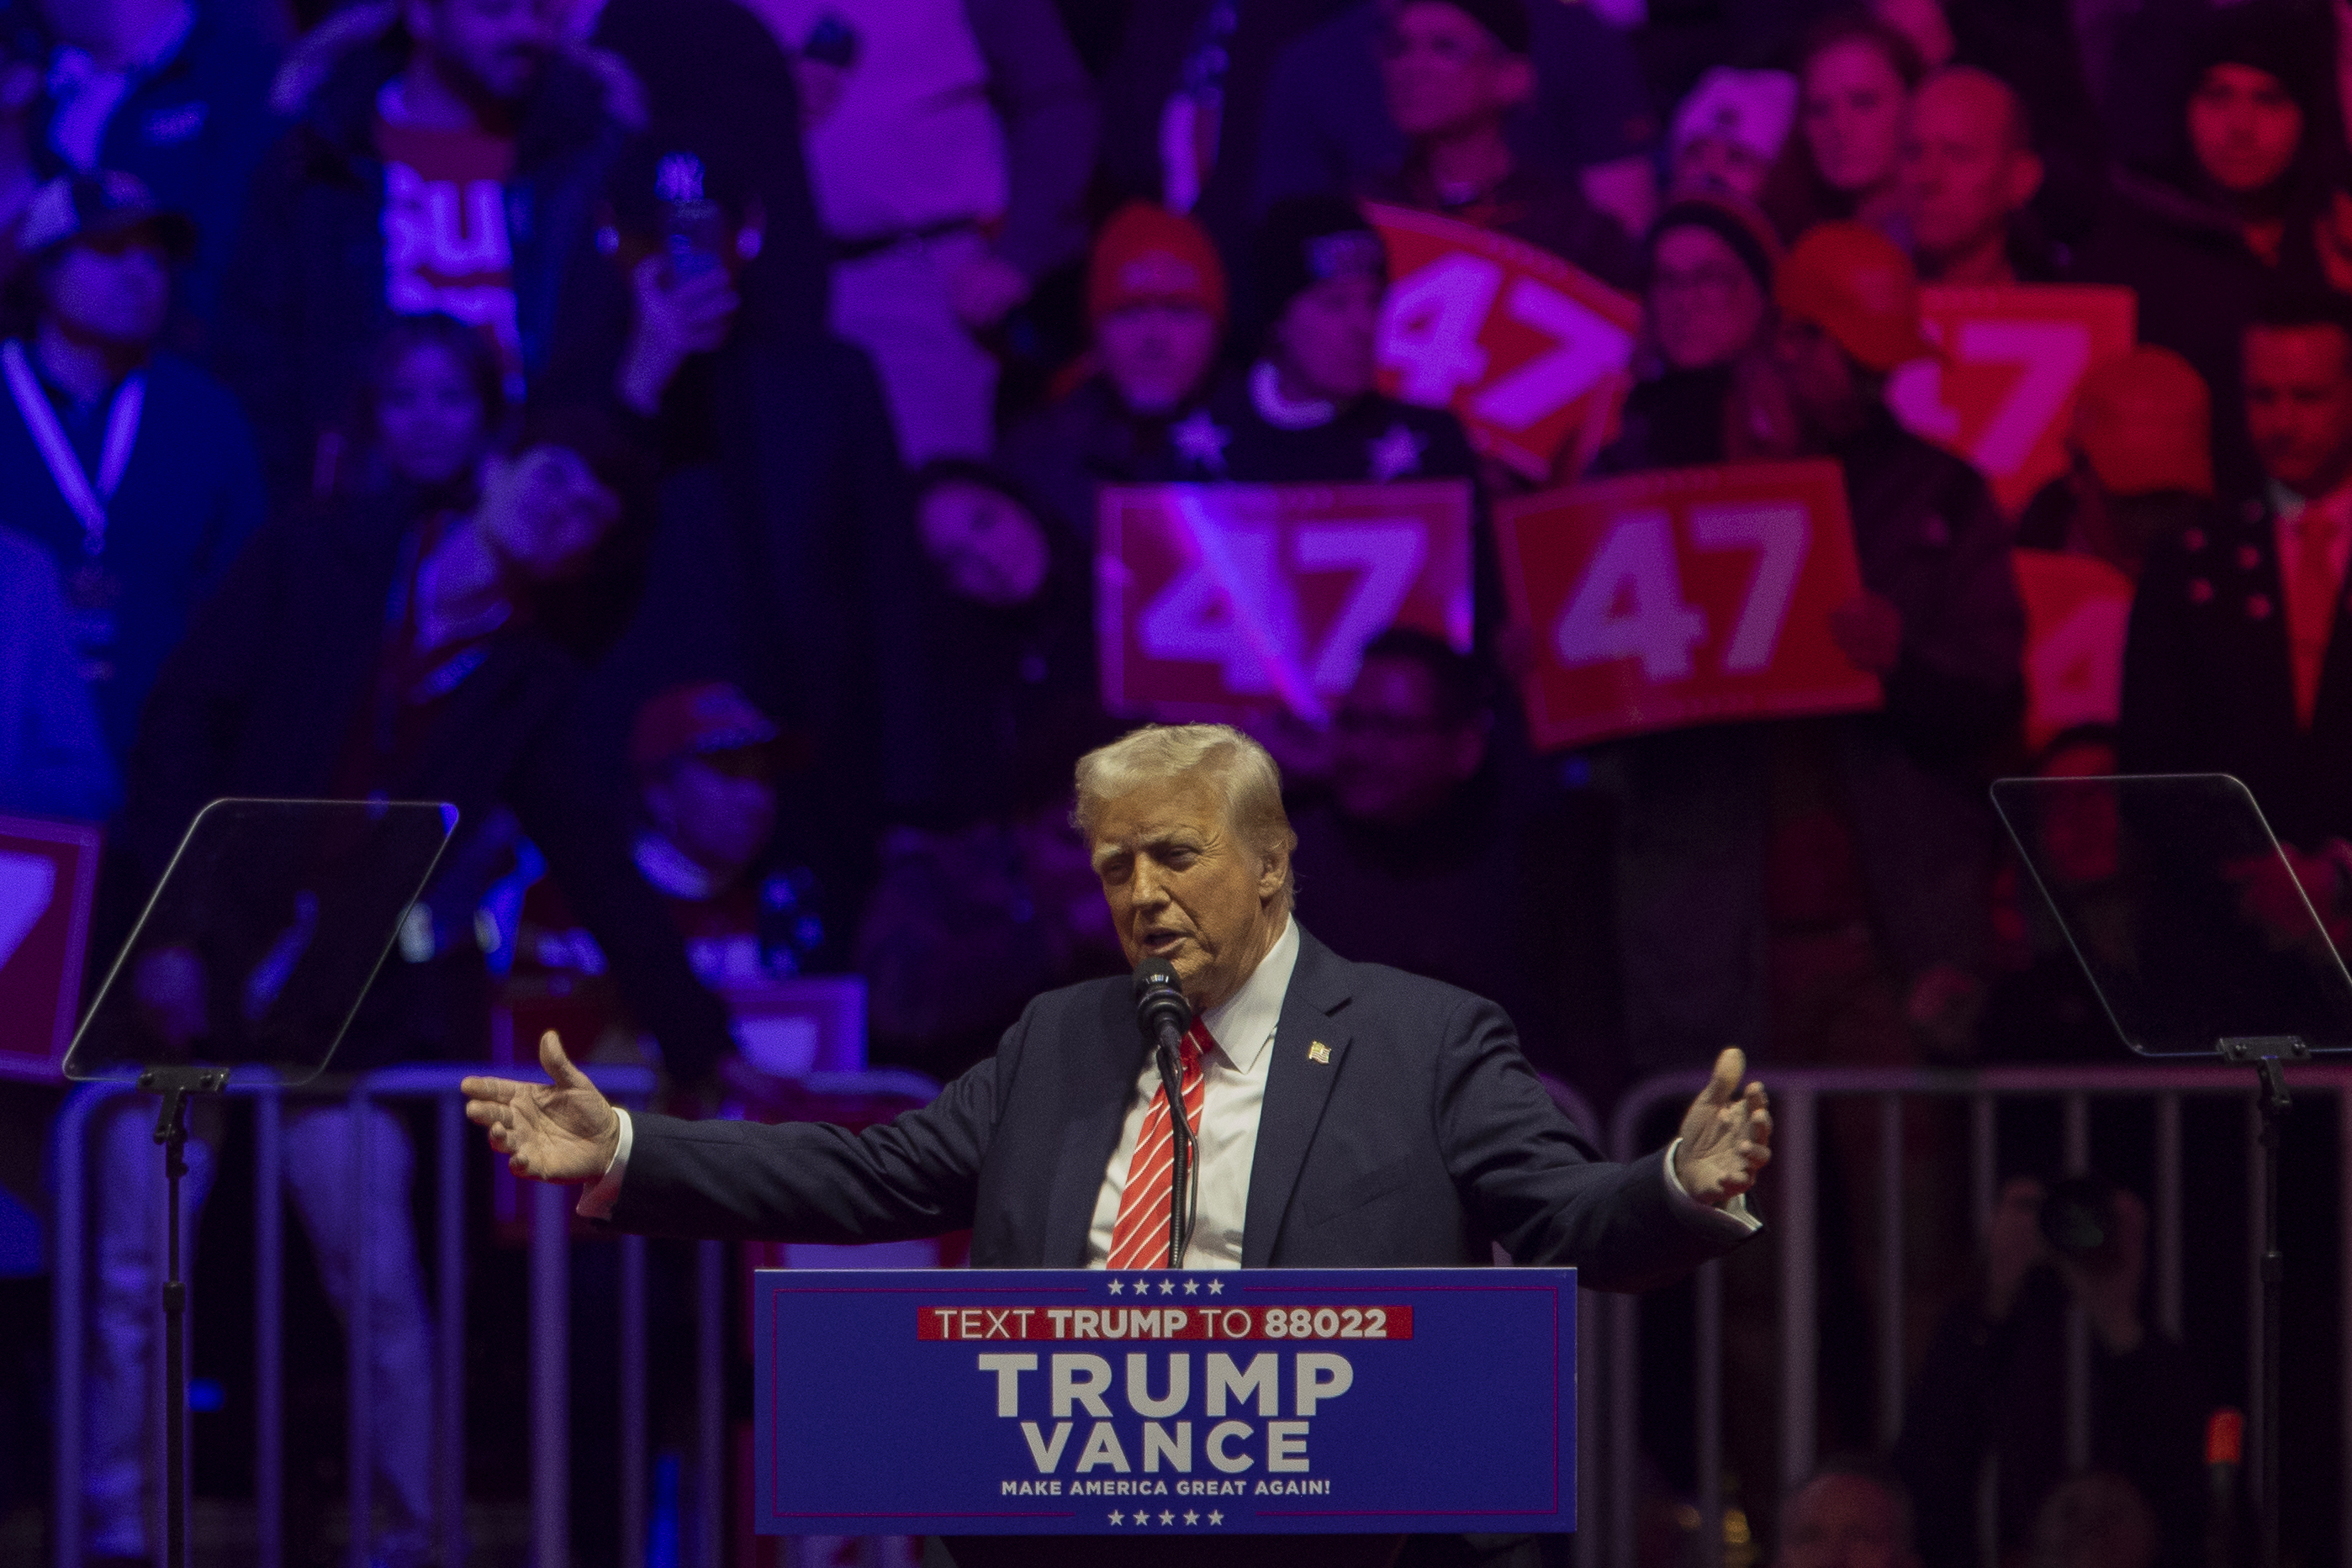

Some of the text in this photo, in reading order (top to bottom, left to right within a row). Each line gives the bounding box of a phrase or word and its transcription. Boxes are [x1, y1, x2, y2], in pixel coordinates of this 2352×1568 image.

[1377, 255, 1633, 433] 47
[1140, 523, 1426, 694] 47
[1554, 504, 1808, 682] 47
[934, 1308, 1387, 1338] TEXT TRUMP TO 88022
[978, 1353, 1354, 1418] TRUMP
[1021, 1420, 1309, 1473] VANCE
[1001, 1480, 1330, 1497] MAKE AMERICA GREAT AGAIN!
